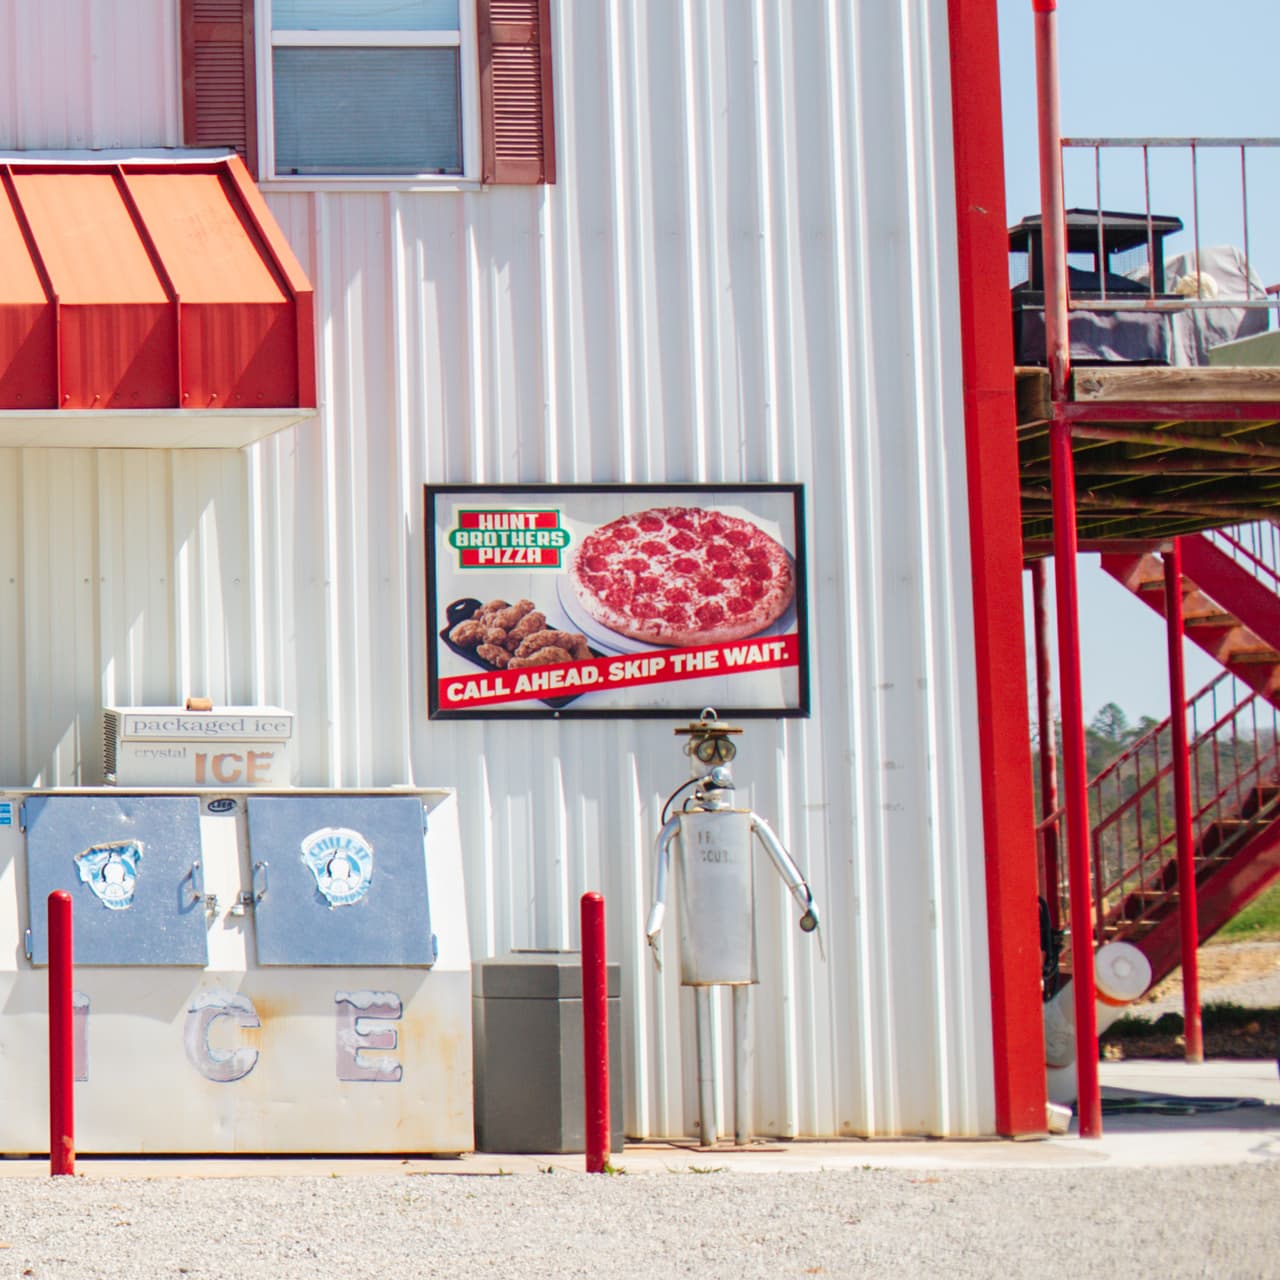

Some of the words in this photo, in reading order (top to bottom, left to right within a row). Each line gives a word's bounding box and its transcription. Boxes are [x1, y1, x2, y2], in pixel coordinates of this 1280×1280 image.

[478, 513, 539, 530] HUNT
[455, 531, 565, 547] BROTHERS
[478, 547, 542, 564] PIZZA
[446, 679, 511, 703] CALL
[514, 667, 604, 695] AHEAD.
[607, 657, 665, 681] SKIP
[670, 650, 719, 672] THE
[719, 640, 790, 667] WAIT.
[133, 718, 245, 735] packaged
[254, 718, 288, 733] ice
[134, 746, 187, 760] crystal
[195, 750, 275, 785] ICE
[73, 989, 403, 1082] ICE
